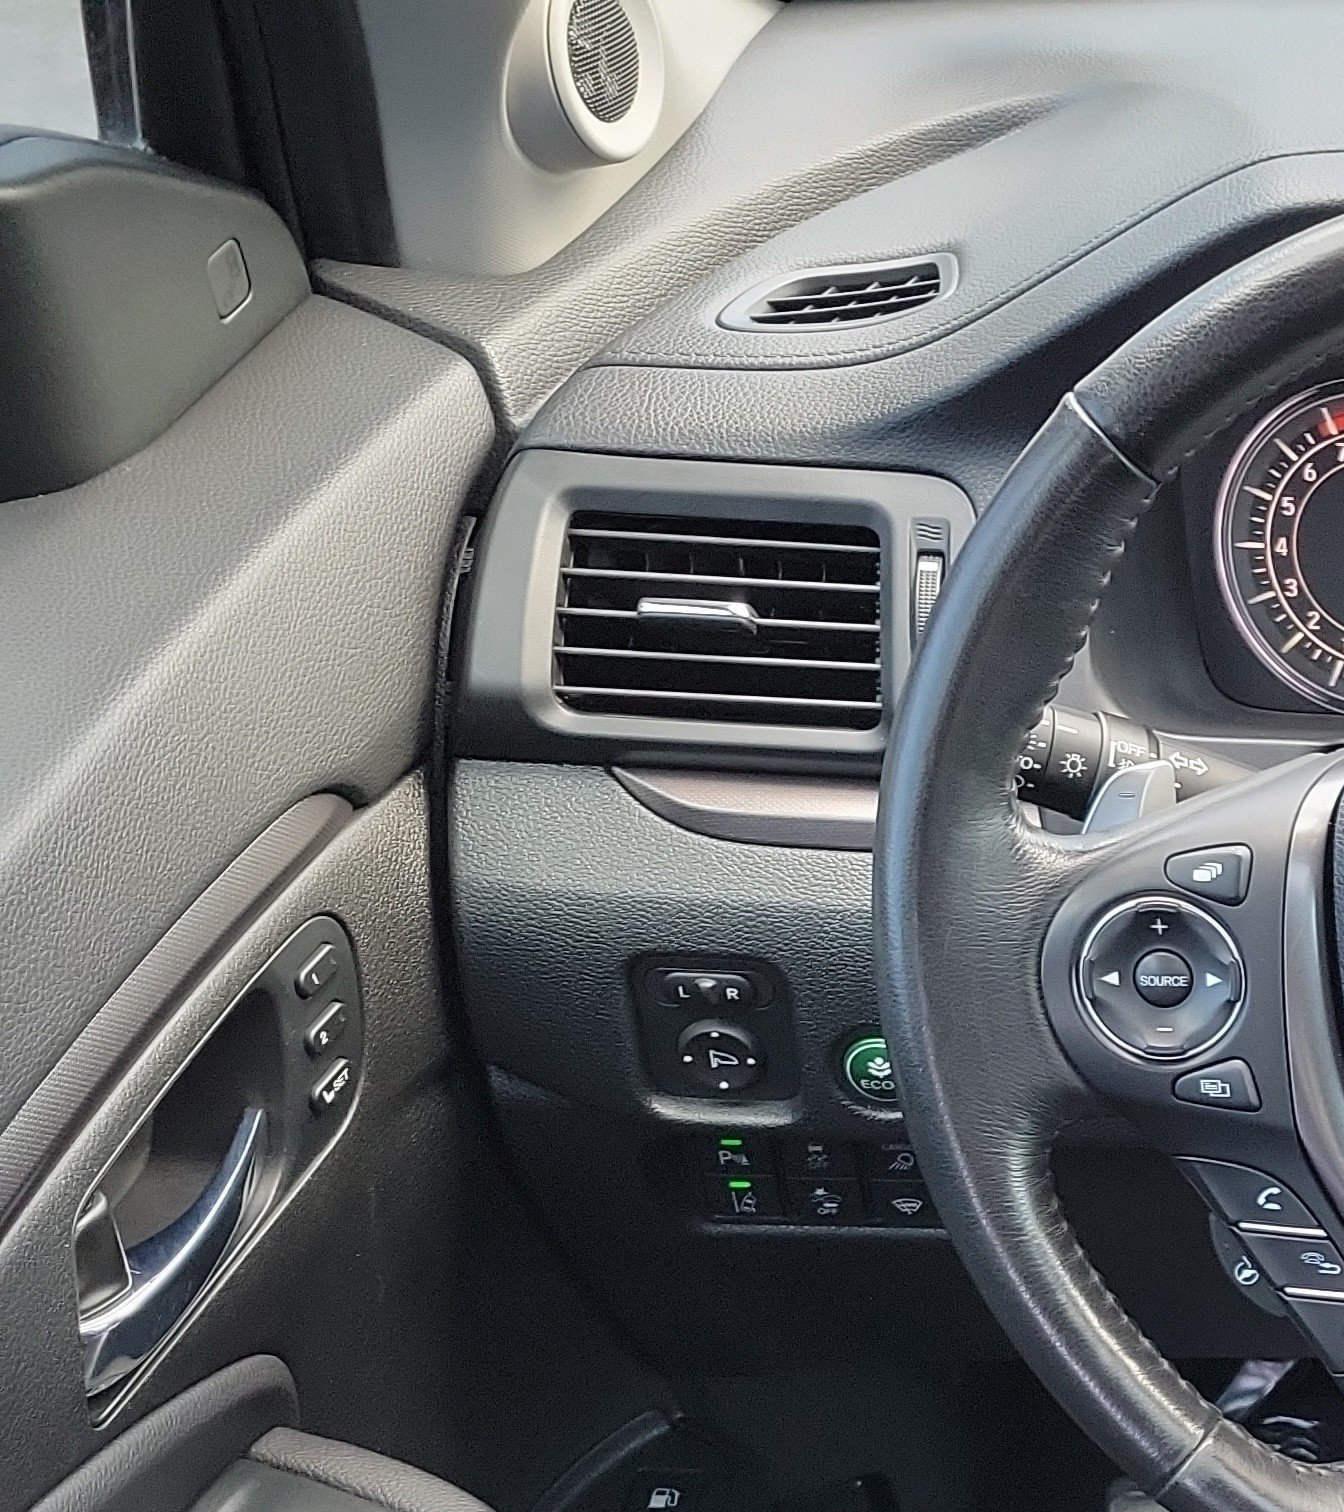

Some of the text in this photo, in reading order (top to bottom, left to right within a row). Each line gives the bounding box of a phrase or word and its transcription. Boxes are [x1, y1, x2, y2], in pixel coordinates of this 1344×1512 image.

[1303, 463, 1317, 482] 6
[1281, 498, 1295, 515] 5
[1275, 537, 1288, 555] 4
[1284, 579, 1298, 596] 3
[1306, 610, 1320, 629] 2
[1117, 740, 1147, 756] OFF
[1139, 973, 1190, 989] SOURCE
[677, 985, 690, 999] L
[725, 986, 740, 1001] R
[860, 1079, 896, 1090] ECO
